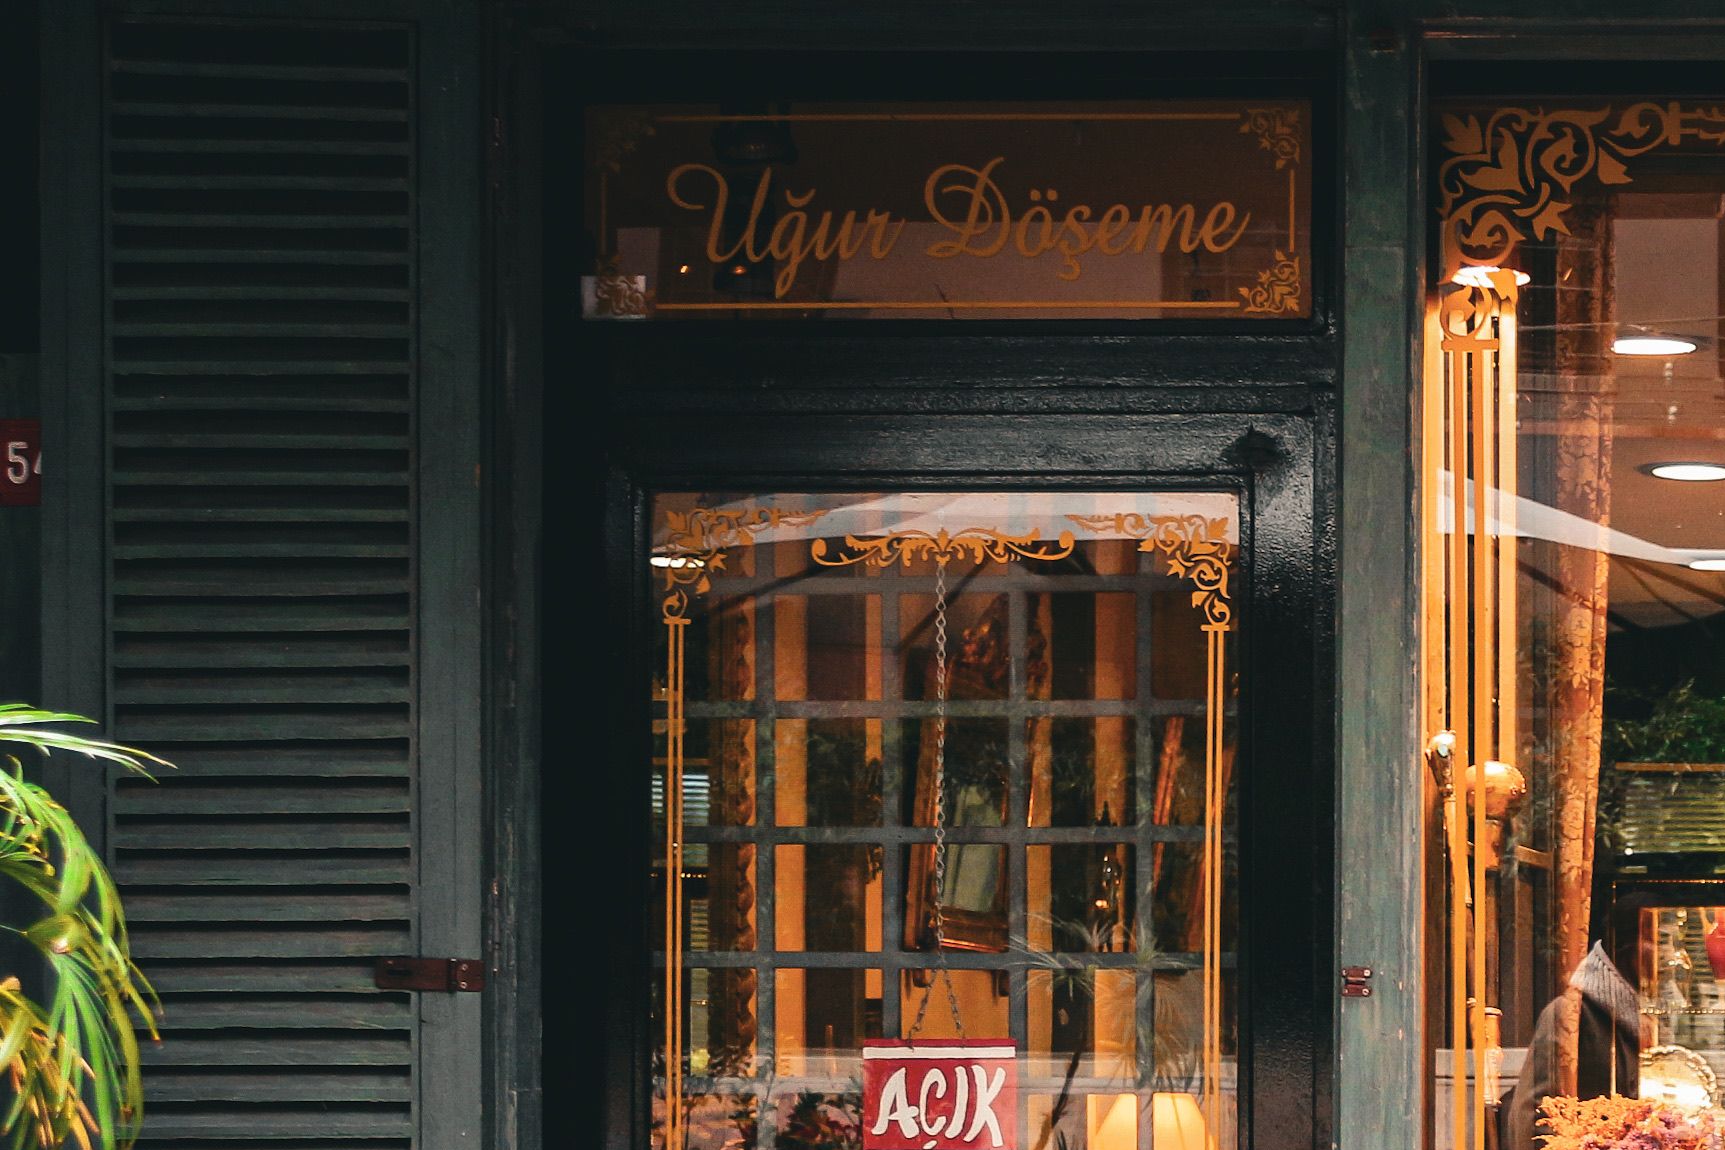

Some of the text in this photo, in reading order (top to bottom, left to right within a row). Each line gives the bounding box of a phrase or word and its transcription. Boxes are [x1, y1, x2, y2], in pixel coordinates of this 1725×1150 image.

[666, 156, 1252, 299] Uğur Döşeme
[870, 1064, 1007, 1150] AÇIK
